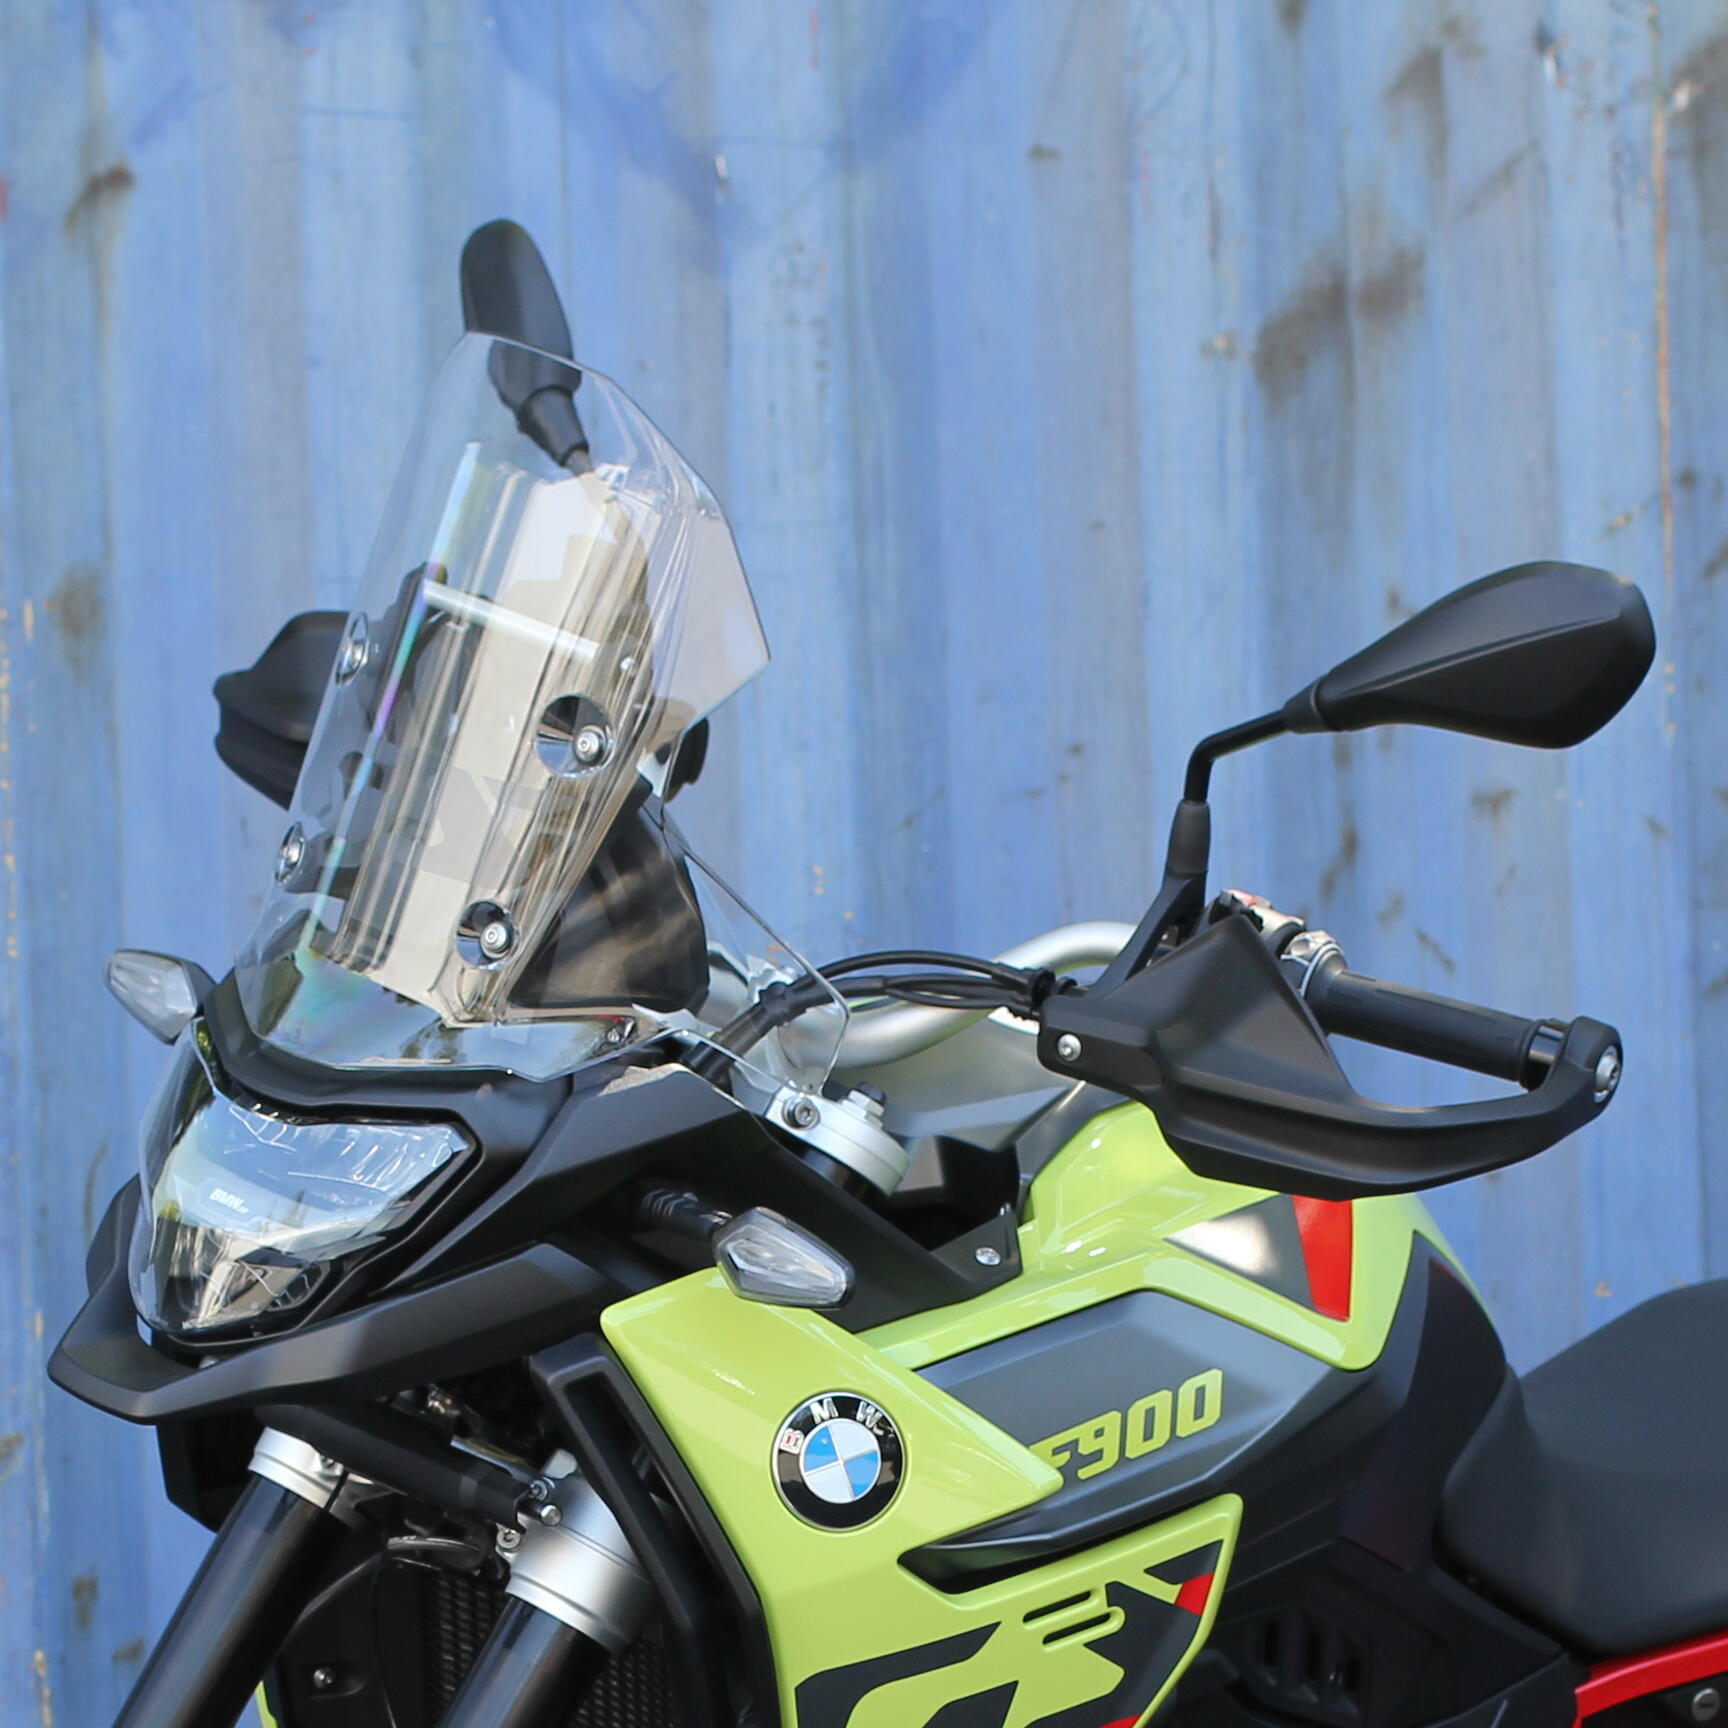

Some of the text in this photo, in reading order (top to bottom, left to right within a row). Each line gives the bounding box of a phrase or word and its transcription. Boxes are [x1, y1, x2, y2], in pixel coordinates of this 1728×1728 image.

[207, 1185, 247, 1212] BMW
[778, 1397, 885, 1455] BMW
[1029, 1367, 1223, 1481] F900
